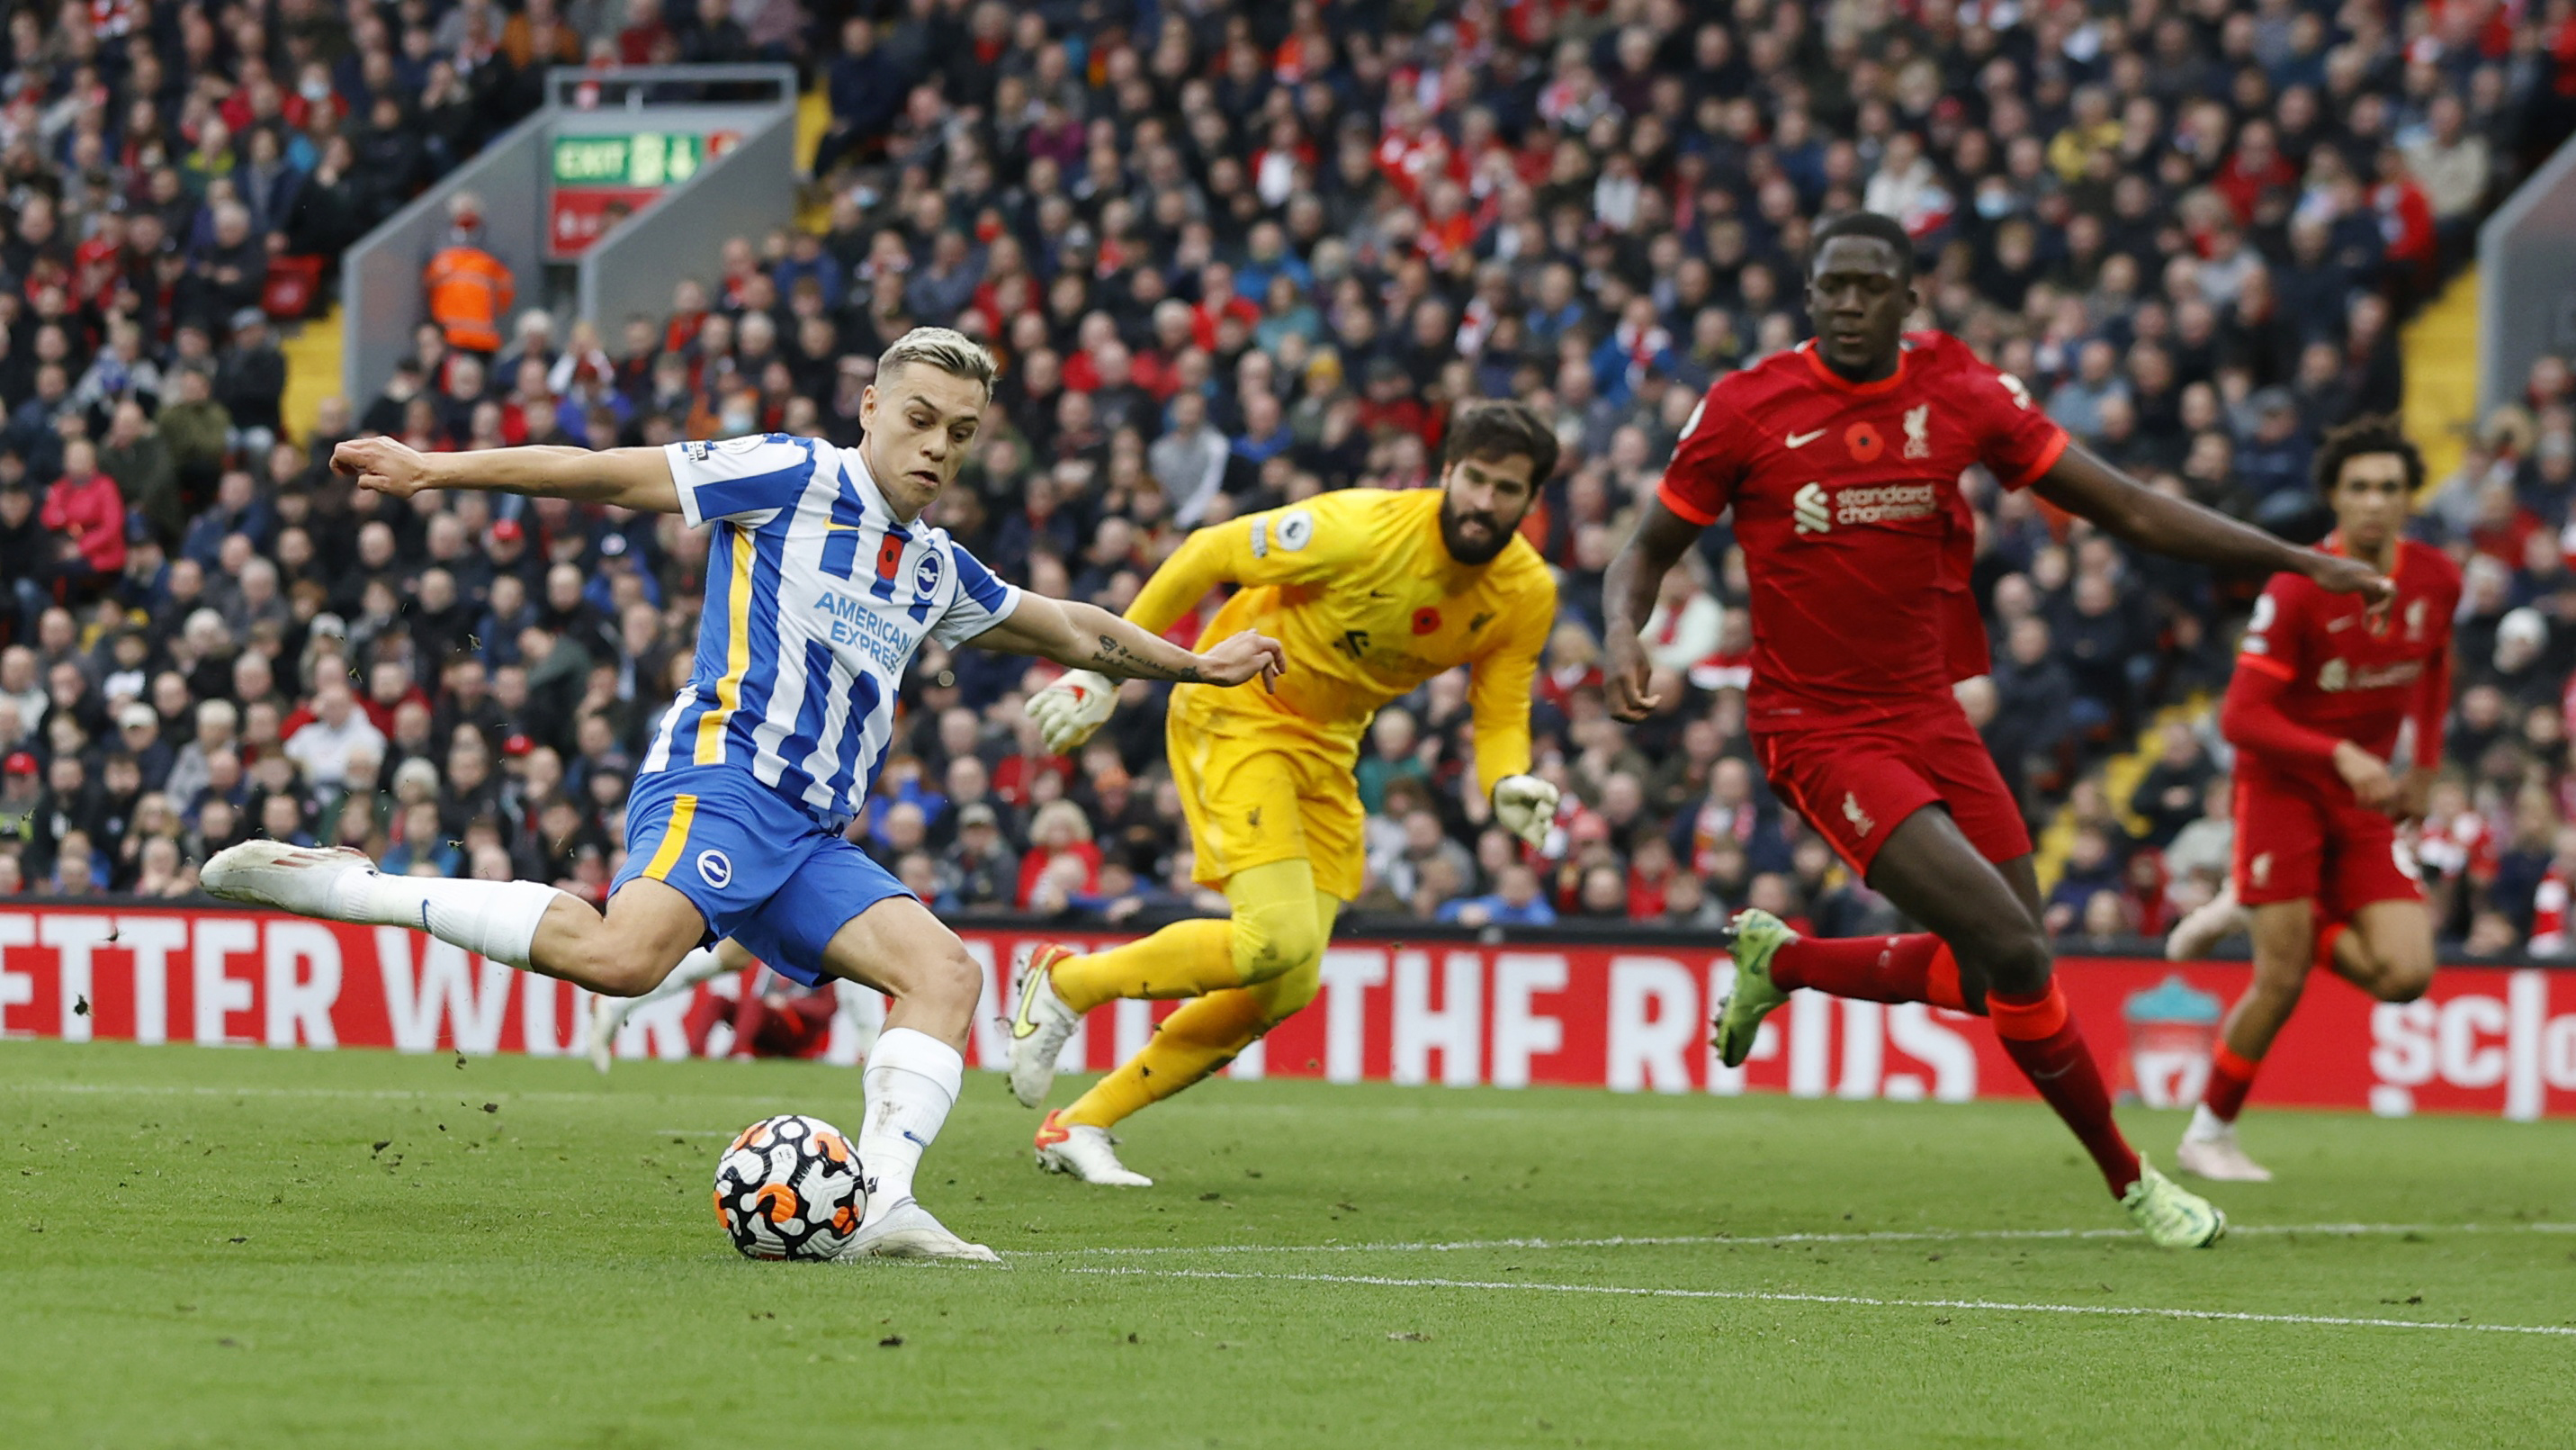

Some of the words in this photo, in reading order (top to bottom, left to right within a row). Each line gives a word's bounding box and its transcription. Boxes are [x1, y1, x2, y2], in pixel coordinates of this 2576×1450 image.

[555, 140, 625, 179] EXIT
[1836, 482, 1934, 509] standard
[813, 591, 912, 655] AMERICAN
